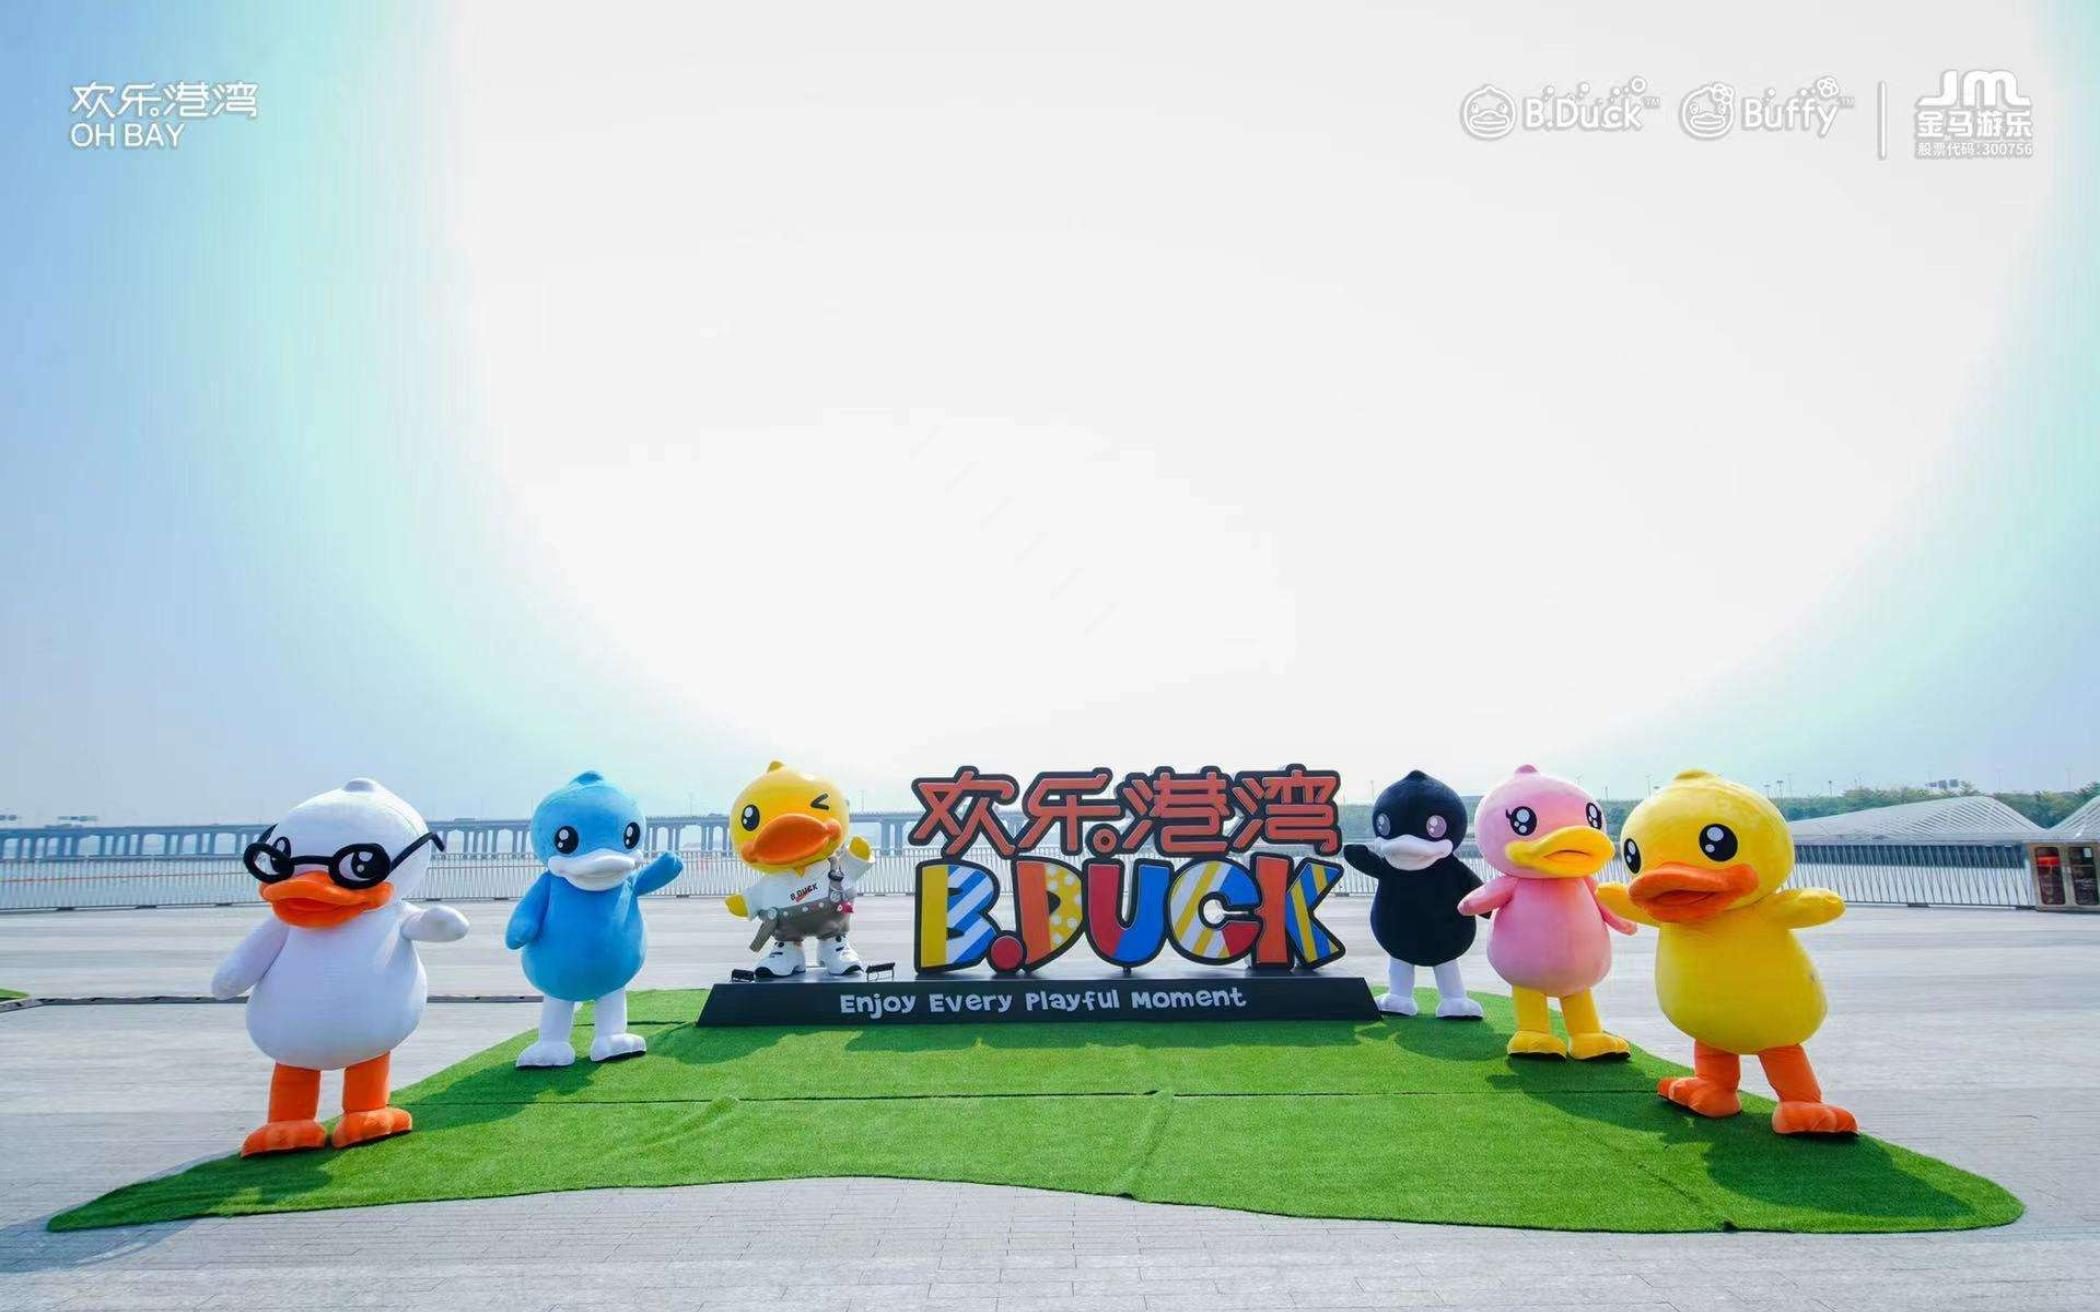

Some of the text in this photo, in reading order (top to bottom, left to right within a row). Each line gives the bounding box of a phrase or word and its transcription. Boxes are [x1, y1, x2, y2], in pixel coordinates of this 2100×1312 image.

[909, 765, 1343, 857] 欢乐港湾
[914, 854, 1345, 973] B.DUCK
[840, 987, 1247, 1019] Enjoy Every Playful Moment
